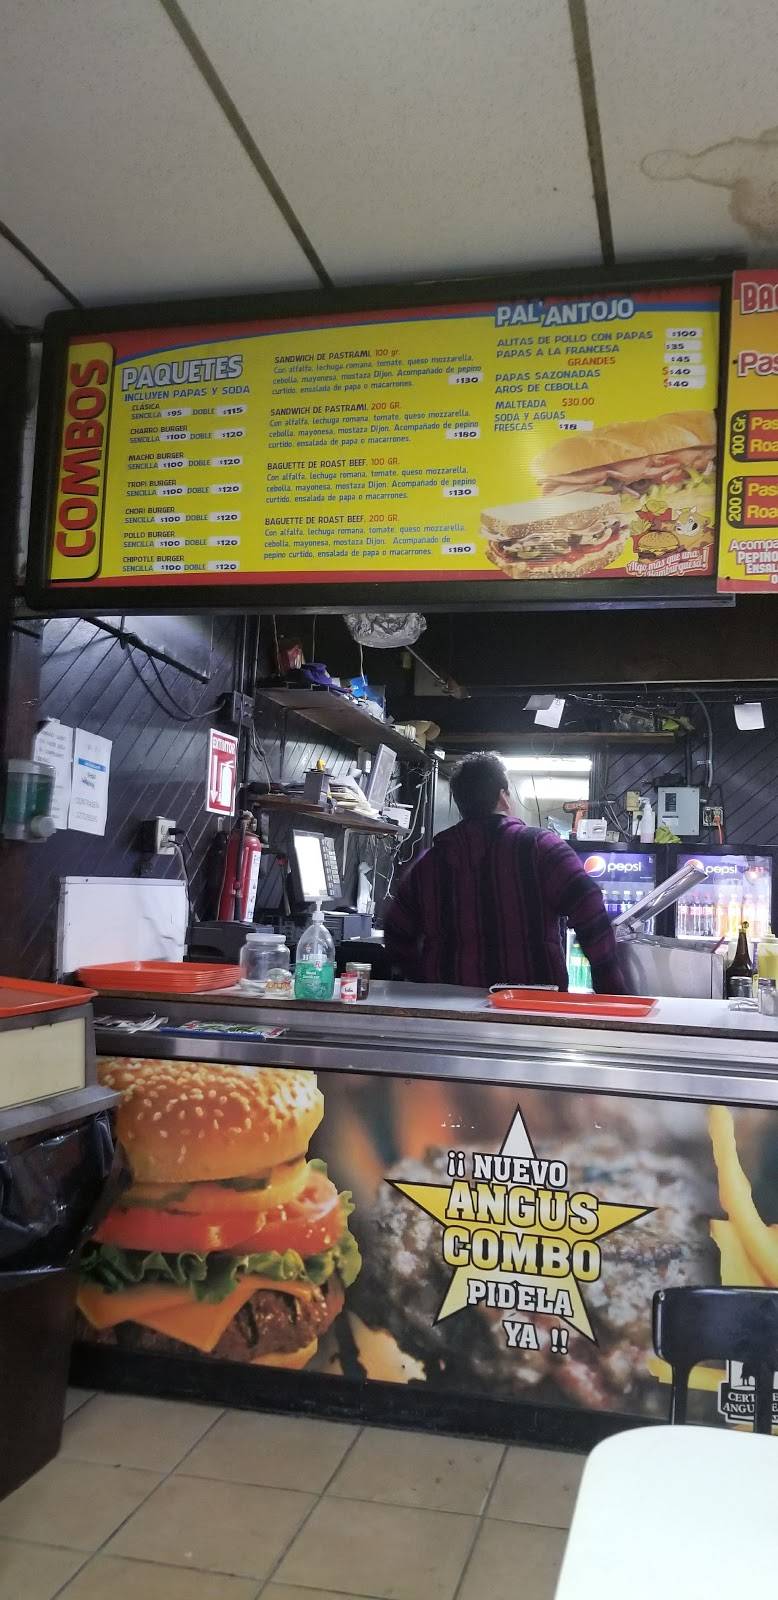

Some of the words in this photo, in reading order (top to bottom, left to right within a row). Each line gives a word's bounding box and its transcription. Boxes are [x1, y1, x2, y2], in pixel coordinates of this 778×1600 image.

[741, 282, 778, 314] BA
[497, 336, 533, 346] ALITAS
[538, 336, 550, 344] DE
[555, 334, 586, 343] POLLO
[592, 332, 612, 341] CON
[616, 330, 653, 340] PAPAS
[496, 349, 532, 358] PAPAS
[536, 348, 544, 356] A
[548, 347, 561, 355] LA
[565, 344, 620, 355] FRANCESA
[274, 354, 314, 364] SANDWICH
[317, 353, 326, 361] DE
[568, 357, 616, 366] GRANDES
[122, 355, 244, 391] PAQUETES
[496, 371, 531, 381] PAPAS
[535, 369, 600, 379] SAZONADAS
[456, 376, 479, 384] $130
[124, 391, 169, 402] INCLUYEN
[173, 388, 206, 398] PAPAS
[212, 387, 218, 395] Y
[222, 384, 250, 395] SODA
[495, 385, 523, 394] AROS
[528, 384, 540, 392] DE
[544, 382, 588, 391] CEBOLLA
[270, 406, 310, 416] SANDWICH
[313, 405, 322, 414] DE
[371, 402, 387, 411] 200
[496, 399, 547, 409] MALTEADA
[495, 413, 519, 422] SODA
[523, 412, 529, 420] Y
[535, 410, 566, 419] AGUAS
[160, 425, 187, 433] BURGER
[494, 423, 533, 432] FRESCAS
[165, 433, 186, 441] $100
[222, 430, 243, 438] $120
[732, 435, 745, 455] 100
[55, 359, 109, 558] COMBOS
[128, 453, 154, 461] MACHO
[157, 452, 184, 460] BURGER
[163, 460, 183, 469] $100
[220, 457, 240, 466] $120
[267, 461, 306, 470] BAGUETTE
[308, 460, 317, 469] DE
[320, 459, 346, 468] ROAST
[371, 458, 385, 466] 100
[267, 473, 279, 481] Con
[310, 471, 336, 480] lechuga
[402, 468, 423, 477] queso
[150, 479, 176, 487] BURGER
[335, 481, 365, 490] mostaza
[453, 477, 476, 487] pepino
[162, 487, 183, 495] $100
[218, 485, 239, 493] $120
[294, 494, 325, 503] ensalada
[328, 493, 336, 501] de
[339, 493, 356, 502] papa
[449, 488, 472, 496] $130
[125, 507, 146, 515] CHORI
[148, 506, 175, 514] BURGER
[729, 498, 742, 521] 200
[160, 515, 180, 523] $100
[217, 513, 237, 521] $120
[265, 516, 303, 526] BAGUETTE
[306, 516, 315, 524] DE
[318, 515, 344, 523] ROAST
[369, 514, 384, 522] 200
[124, 531, 145, 539] POLLO
[160, 539, 180, 547] $100
[217, 538, 238, 546] $120
[123, 555, 154, 563] CHIPOTLE
[157, 554, 184, 562] BURGER
[161, 563, 181, 572] $100
[215, 562, 236, 570] $120
[607, 861, 642, 875] pepsi
[473, 1153, 567, 1188] NUEVO
[445, 1180, 599, 1235] ANGUS
[443, 1226, 600, 1282] COMBO
[503, 1320, 539, 1350] YA
